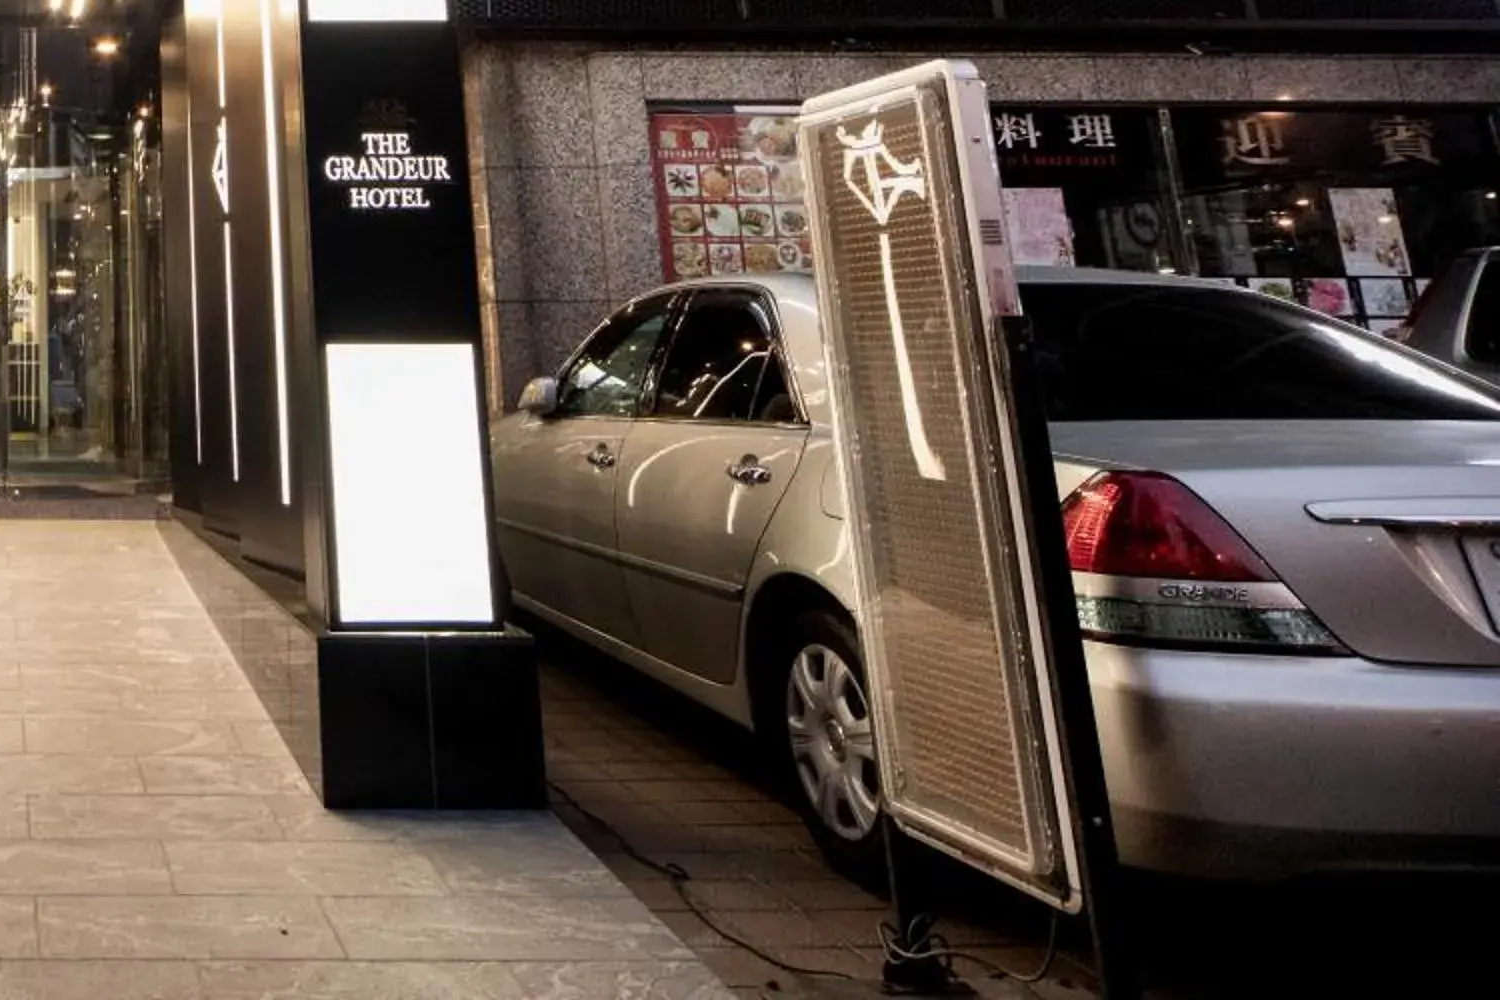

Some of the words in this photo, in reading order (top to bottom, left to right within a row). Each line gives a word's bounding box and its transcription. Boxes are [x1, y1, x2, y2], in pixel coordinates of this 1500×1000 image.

[994, 113, 1117, 149] 料理
[361, 132, 410, 155] THE
[324, 155, 451, 181] GRANDEUR
[350, 186, 430, 208] HOTEL
